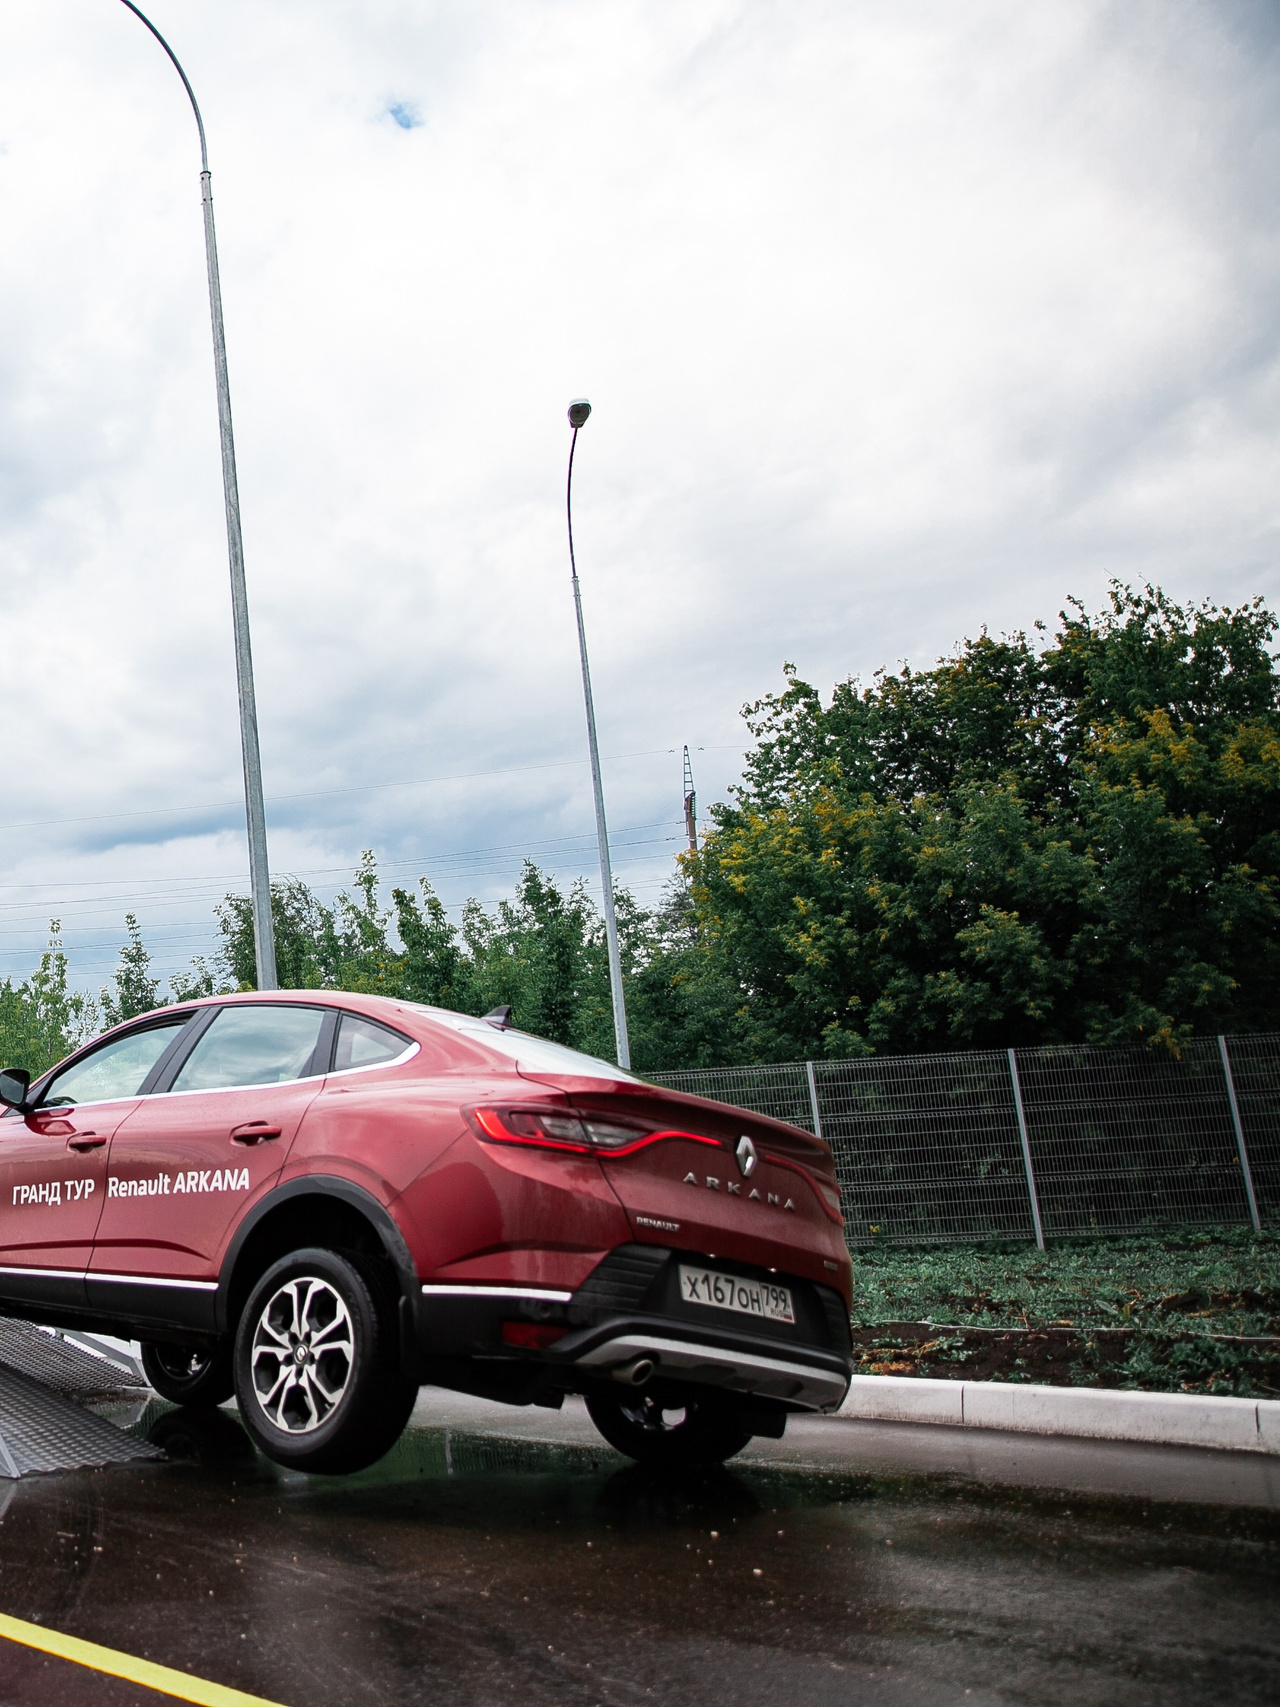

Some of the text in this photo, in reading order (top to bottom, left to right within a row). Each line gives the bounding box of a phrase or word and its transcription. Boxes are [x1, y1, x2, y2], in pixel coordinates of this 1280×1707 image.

[12, 1168, 250, 1206] ГРАНД ТУР Renault ARKANA
[683, 1172, 795, 1210] ARKANA
[636, 1216, 680, 1232] RENAULT
[762, 1284, 787, 1310] 799
